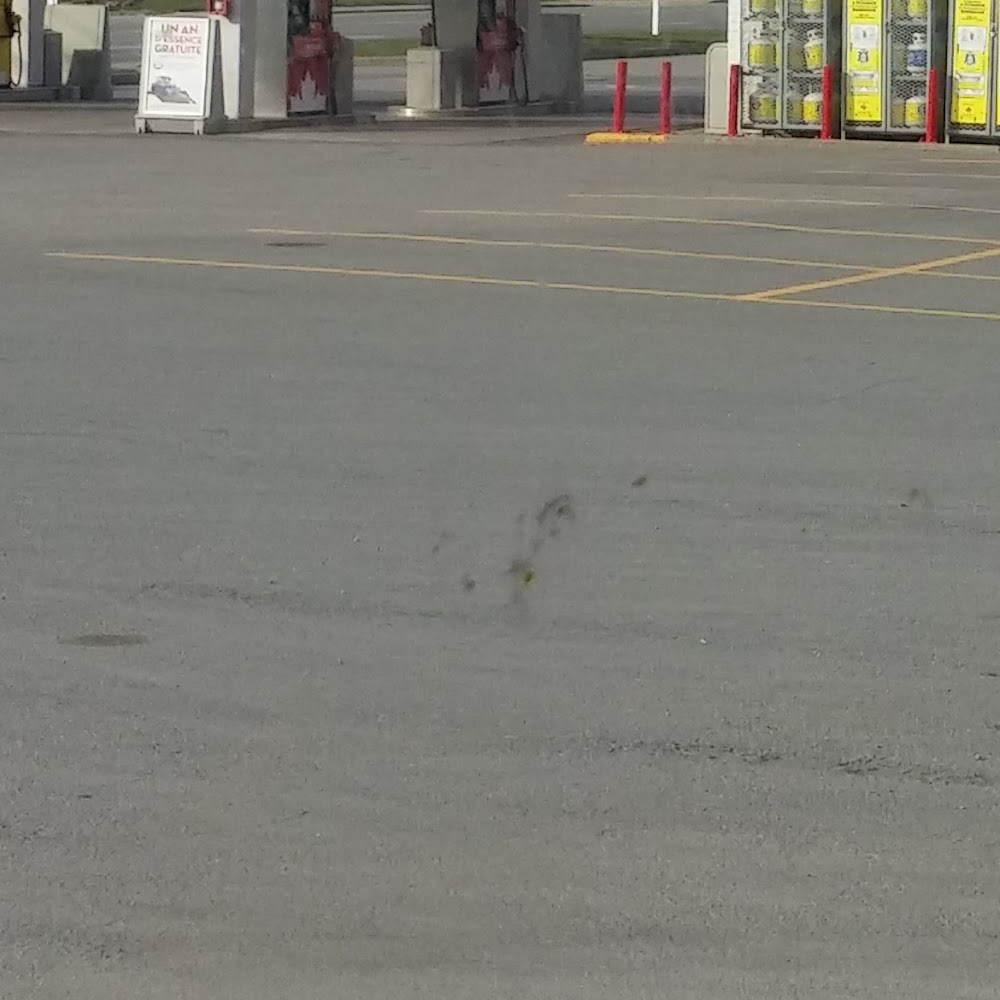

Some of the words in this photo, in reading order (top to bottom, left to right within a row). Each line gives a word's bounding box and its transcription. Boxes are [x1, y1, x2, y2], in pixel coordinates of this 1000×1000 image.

[161, 23, 179, 34] UN
[181, 25, 199, 34] AN
[154, 44, 201, 55] GRATUITE
